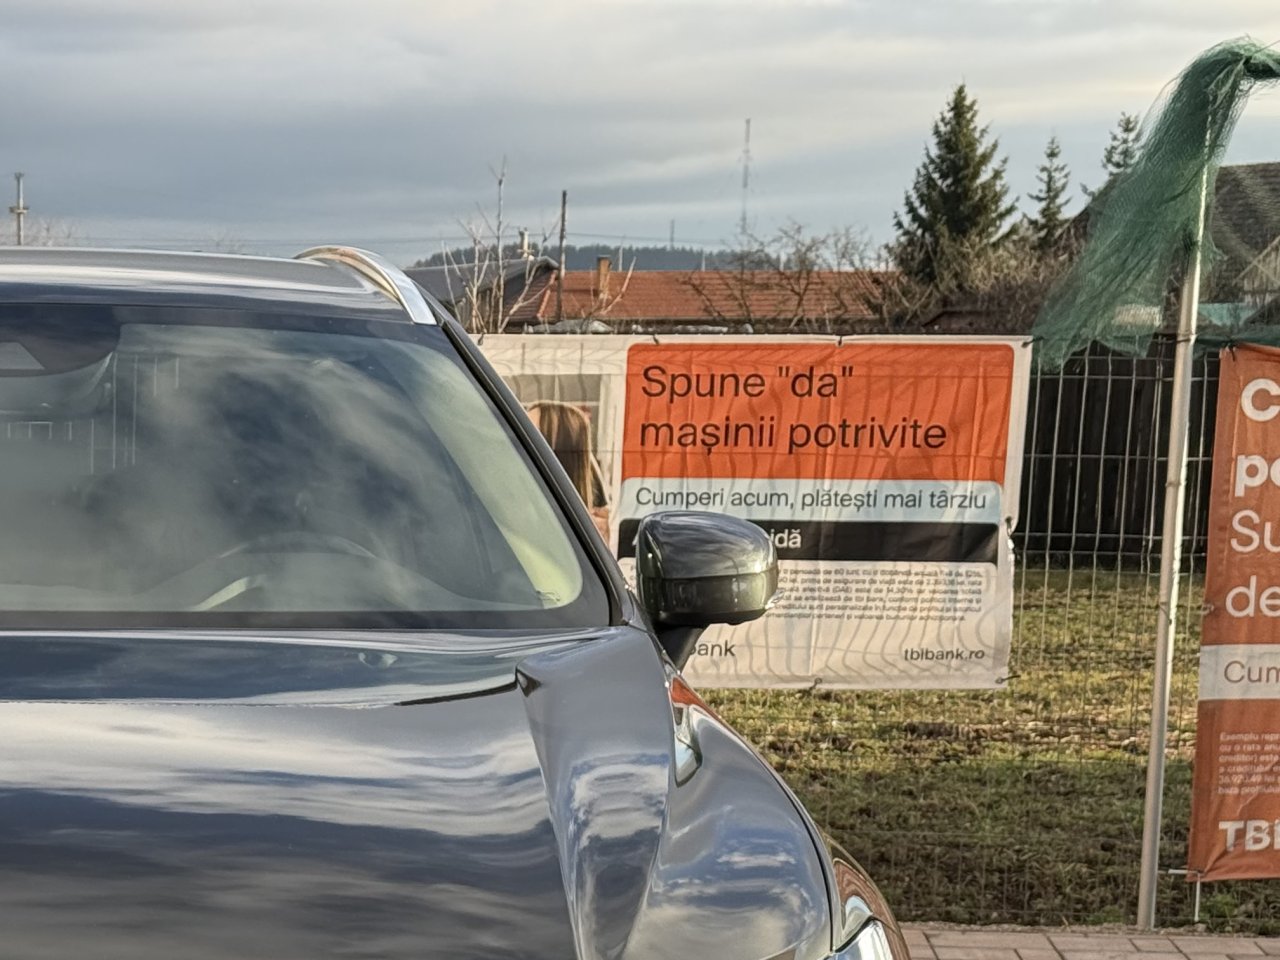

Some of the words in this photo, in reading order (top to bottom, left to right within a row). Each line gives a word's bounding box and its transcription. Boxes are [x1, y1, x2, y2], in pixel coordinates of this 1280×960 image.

[640, 365, 766, 404] Spune
[777, 365, 855, 398] "da"
[639, 415, 776, 456] mașinii
[787, 416, 948, 455] potrivite
[635, 486, 725, 509] Cumperi
[730, 490, 795, 510] acum,
[800, 488, 878, 512] plătești
[884, 489, 922, 508] mai
[929, 489, 987, 509] târziu
